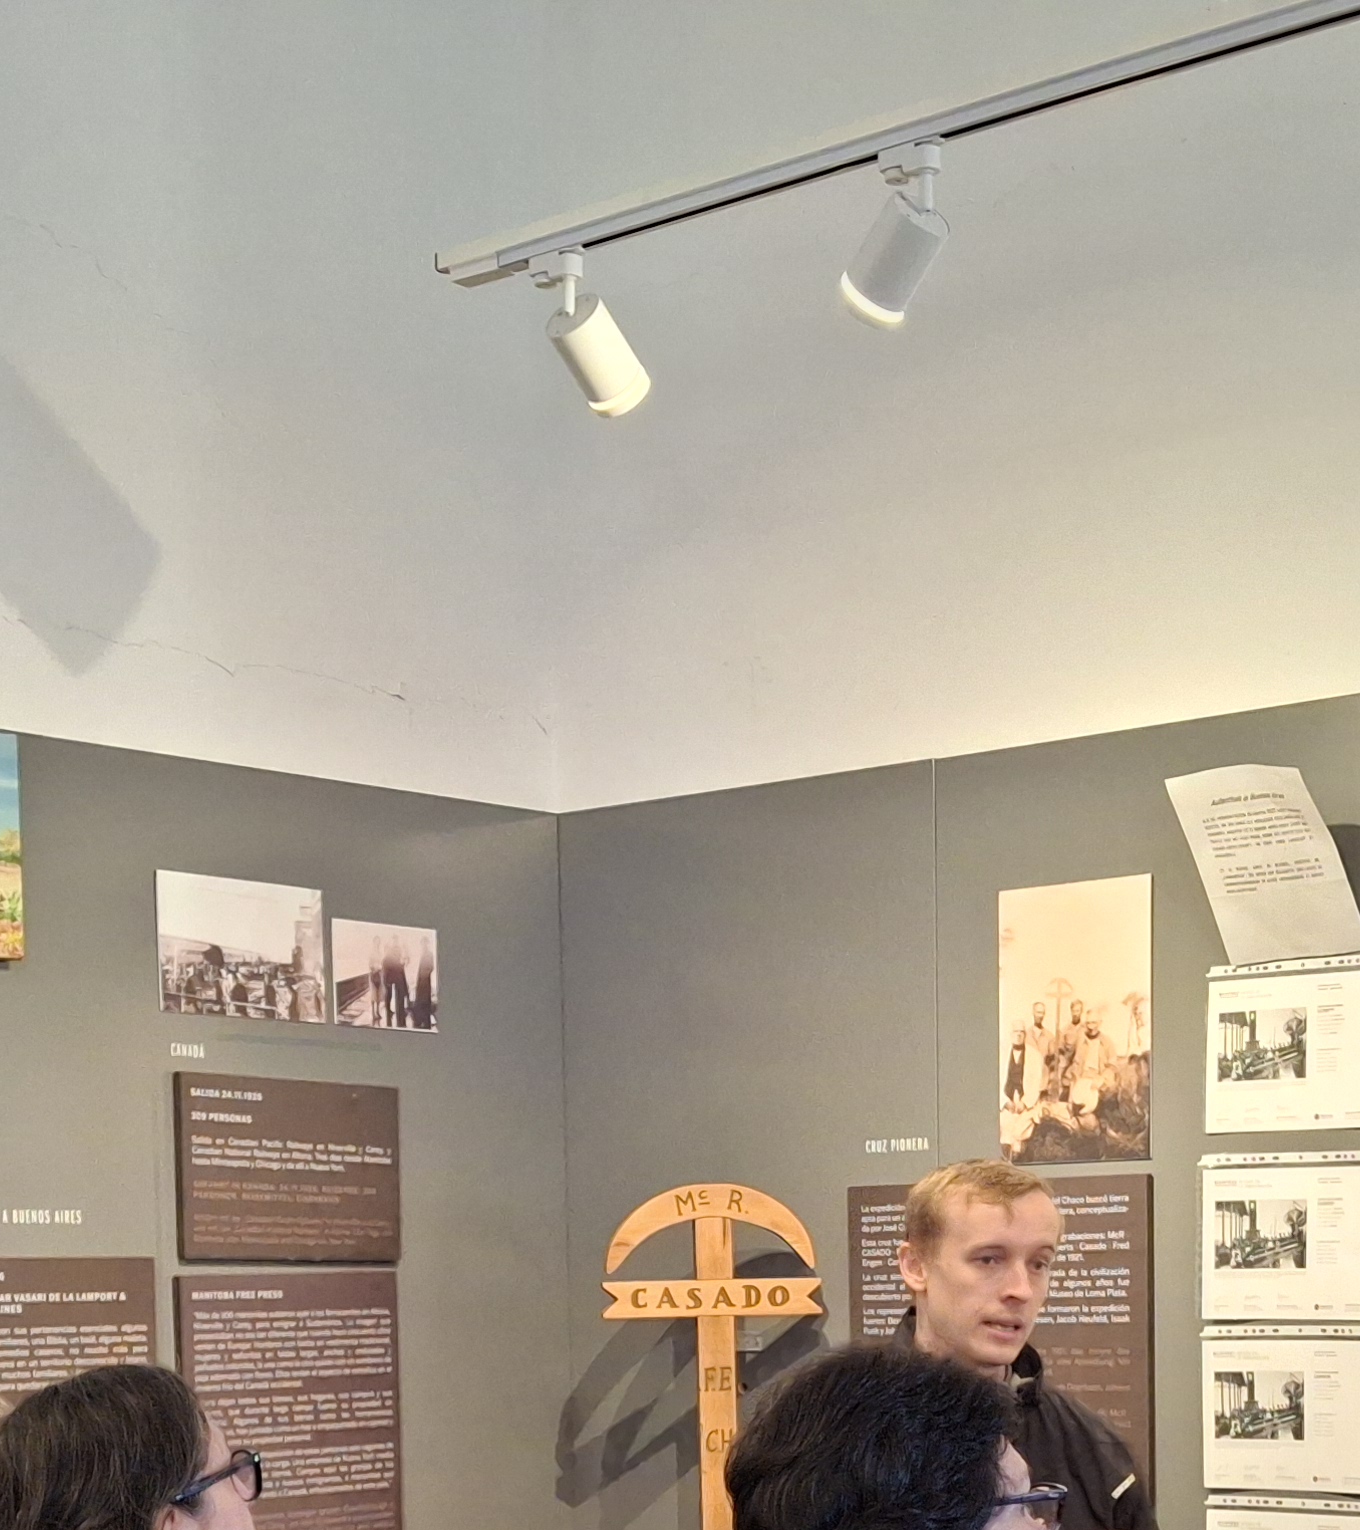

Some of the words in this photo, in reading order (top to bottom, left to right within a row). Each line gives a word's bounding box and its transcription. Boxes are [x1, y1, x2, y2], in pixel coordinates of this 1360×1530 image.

[170, 1042, 204, 1058] CANADÁ
[865, 1139, 887, 1153] CRUZ
[890, 1137, 928, 1151] PIONERA
[727, 1189, 749, 1215] R.
[2, 1209, 8, 1223] A
[12, 1209, 50, 1224] BUENOS
[54, 1209, 81, 1224] AIRES
[631, 1285, 791, 1310] CASADO
